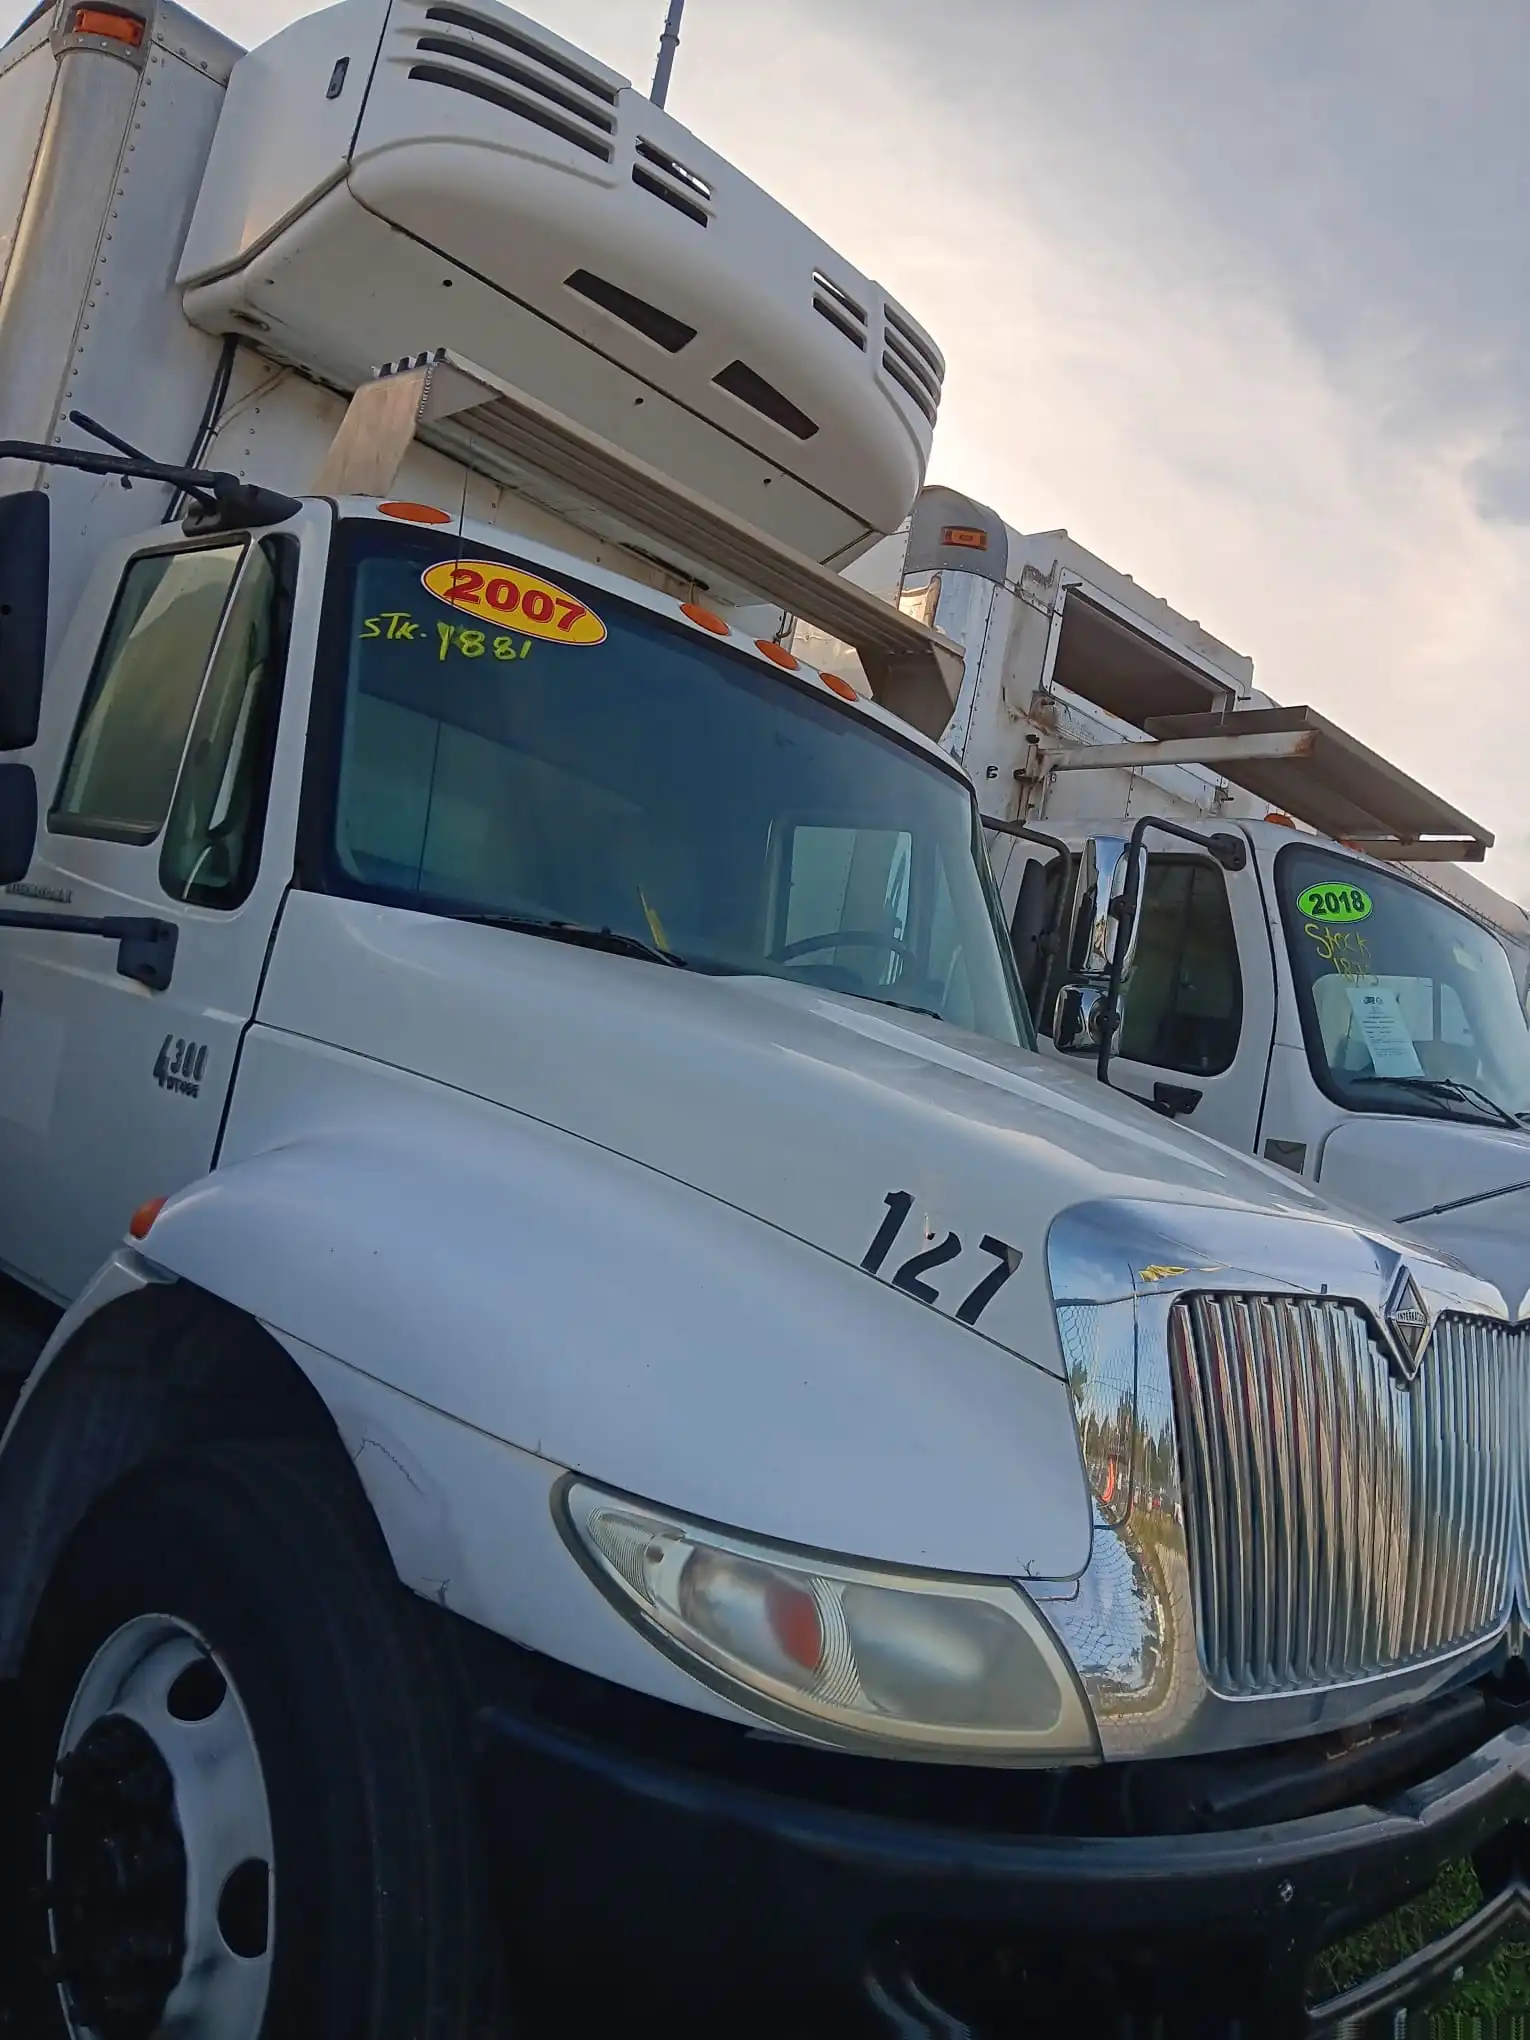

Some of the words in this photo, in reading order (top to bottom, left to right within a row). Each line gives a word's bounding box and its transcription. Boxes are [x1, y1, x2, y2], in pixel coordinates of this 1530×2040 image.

[443, 568, 587, 632] 2007
[1308, 890, 1366, 915] 2018
[860, 1190, 1023, 1325] 127
